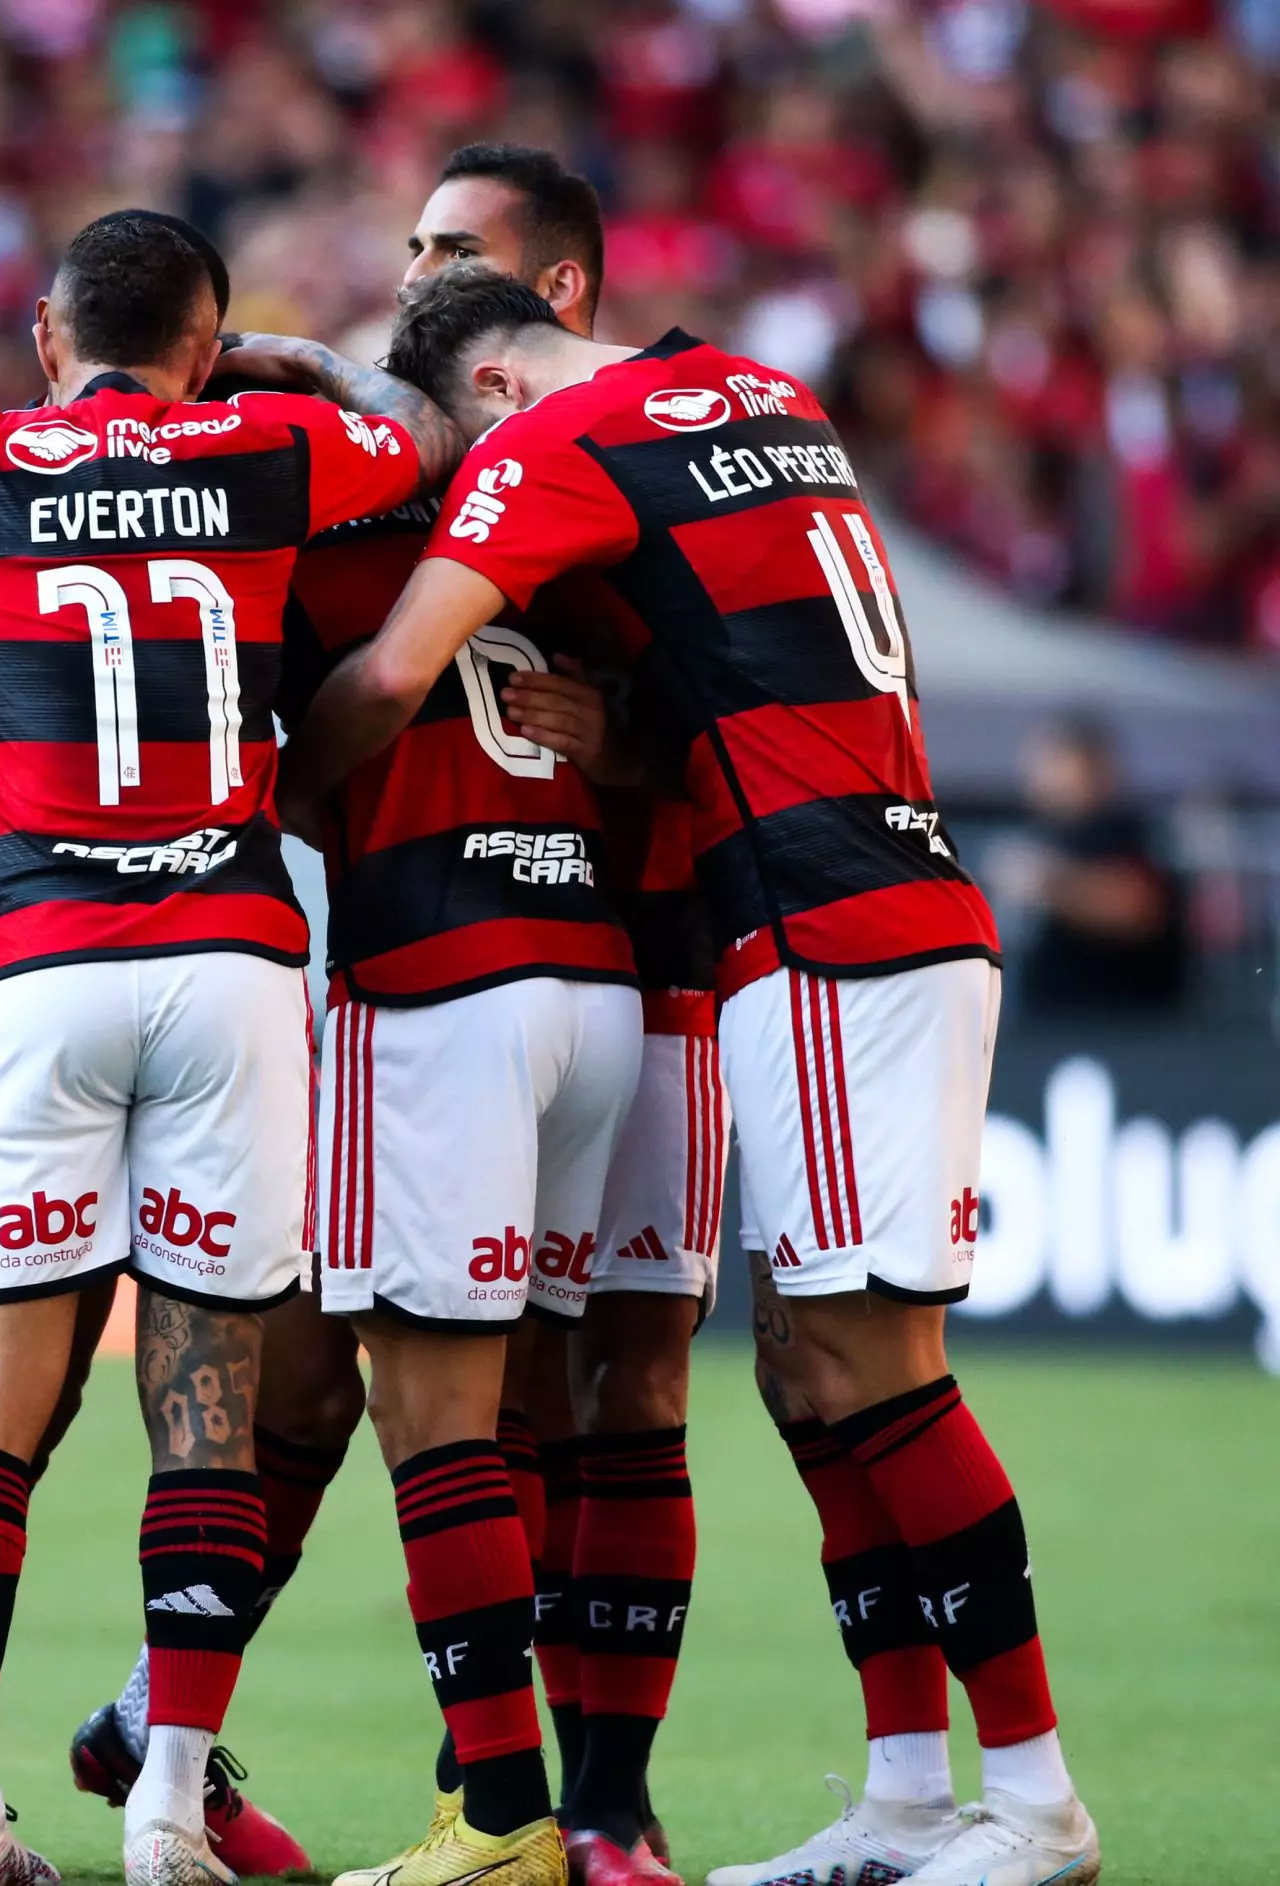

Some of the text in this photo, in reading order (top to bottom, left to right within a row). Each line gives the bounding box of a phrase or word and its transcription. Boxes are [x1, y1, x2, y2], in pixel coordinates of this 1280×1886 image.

[738, 390, 788, 417] livre
[107, 414, 242, 444] mercado
[107, 435, 172, 465] livre
[688, 444, 774, 502] LÉO
[30, 488, 230, 543] EVERTON
[100, 611, 120, 644] TIM
[210, 608, 228, 643] TIM
[806, 511, 912, 734] 4
[139, 1187, 237, 1258] abc
[0, 1254, 21, 1268] da
[134, 1232, 226, 1276] da construção
[467, 1287, 487, 1300] da
[588, 1600, 686, 1633] CRF
